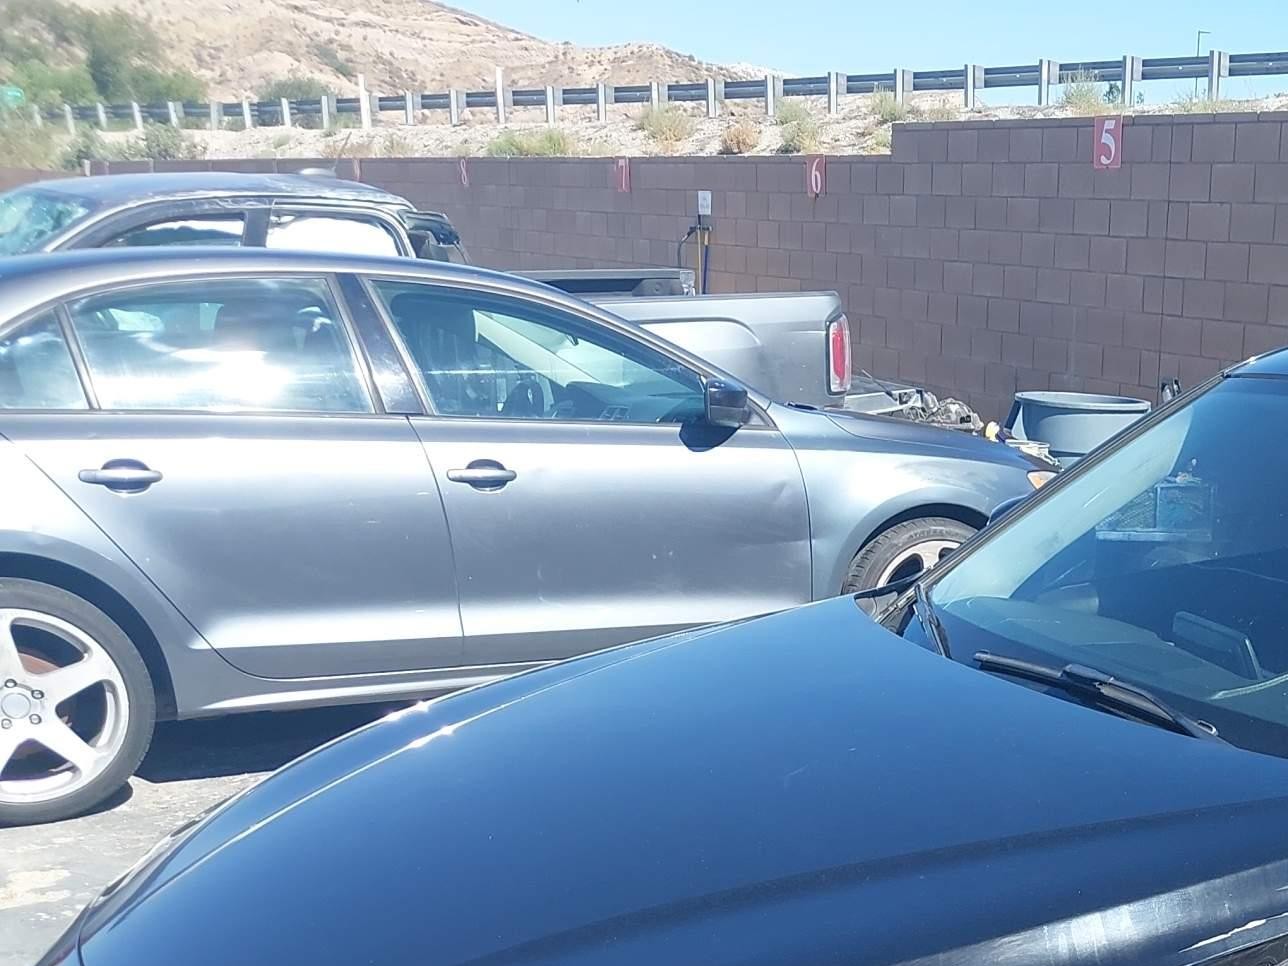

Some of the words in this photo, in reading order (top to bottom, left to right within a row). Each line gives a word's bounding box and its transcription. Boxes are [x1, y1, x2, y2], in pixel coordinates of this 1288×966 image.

[1100, 119, 1116, 165] 5
[460, 159, 468, 185] 8
[811, 158, 822, 194] 6
